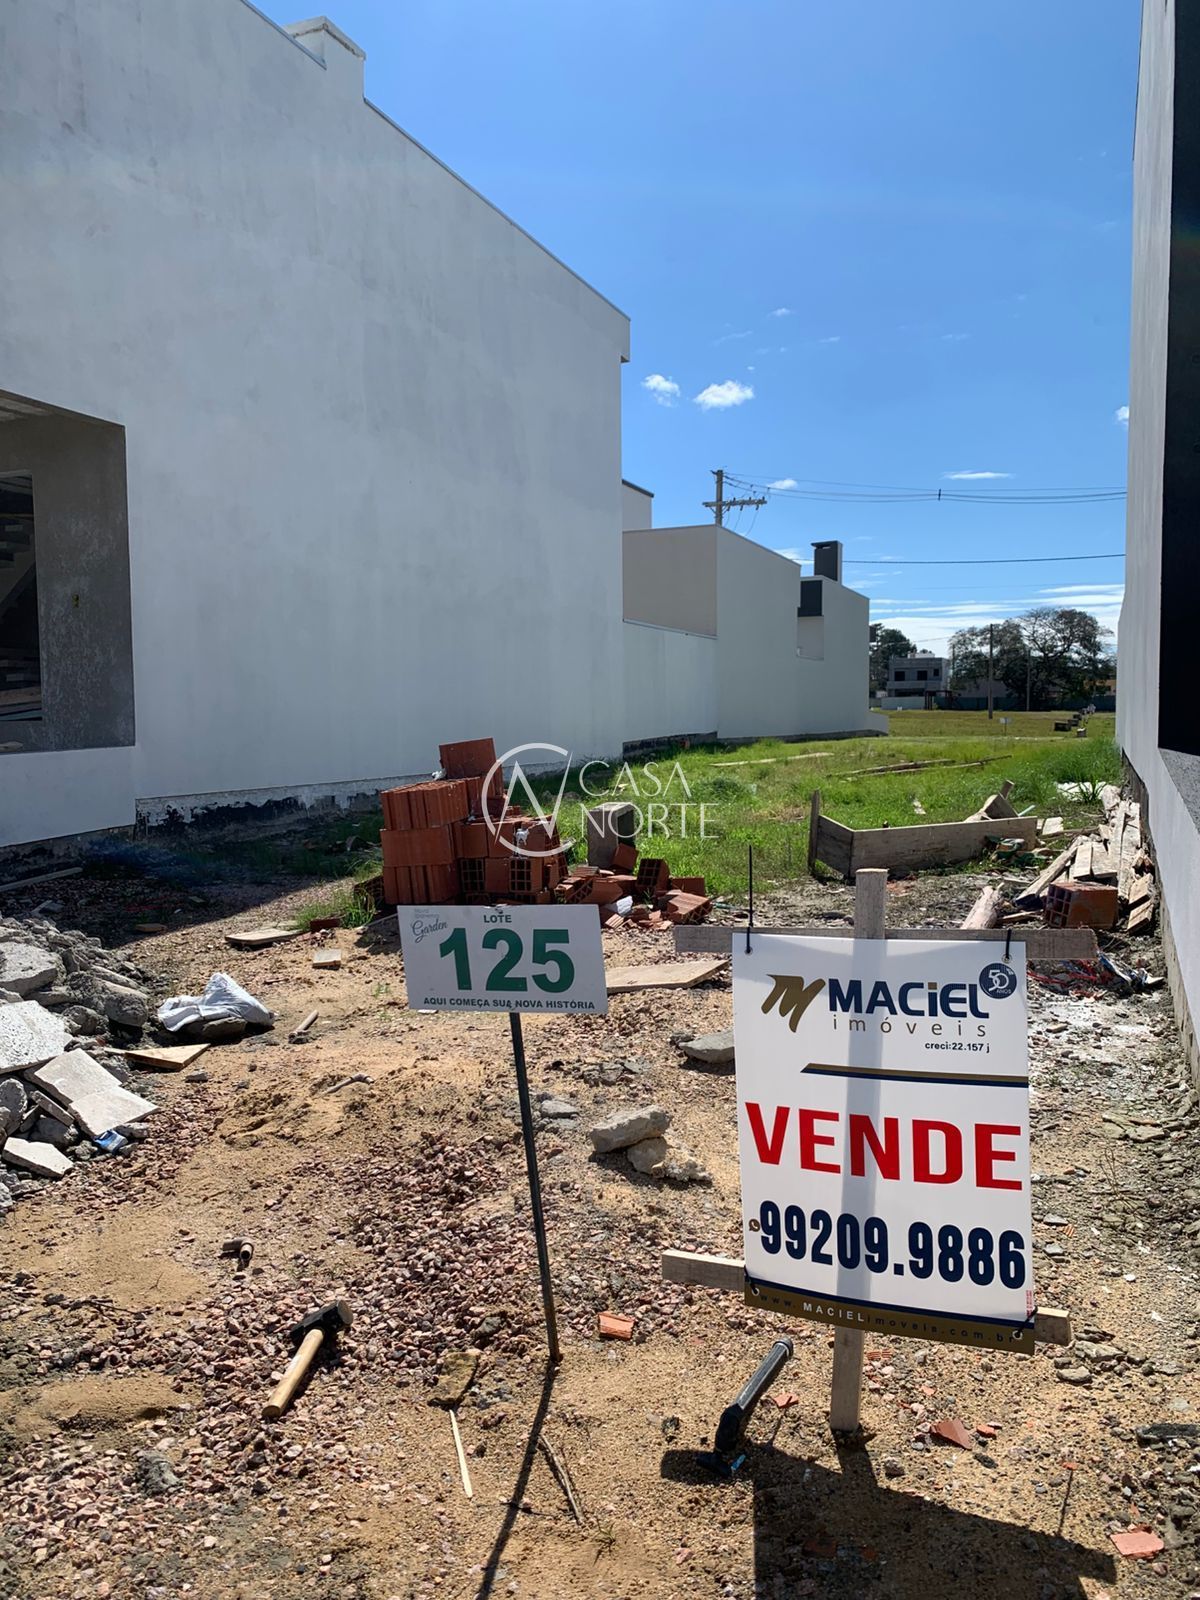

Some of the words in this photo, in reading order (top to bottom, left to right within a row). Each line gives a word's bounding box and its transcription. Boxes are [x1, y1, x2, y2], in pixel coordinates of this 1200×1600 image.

[411, 919, 448, 943] Garden
[483, 914, 512, 924] LOTE
[439, 927, 575, 993] 125
[423, 997, 447, 1006] AQUI
[449, 998, 490, 1007] COMEÇA
[492, 999, 512, 1009] SUA
[515, 999, 543, 1009] NOVA
[546, 999, 595, 1010] HISTÓRIA
[833, 1014, 986, 1037] imóveis
[745, 1102, 1022, 1191] VENDE
[759, 1200, 1026, 1289] 99209.9886
